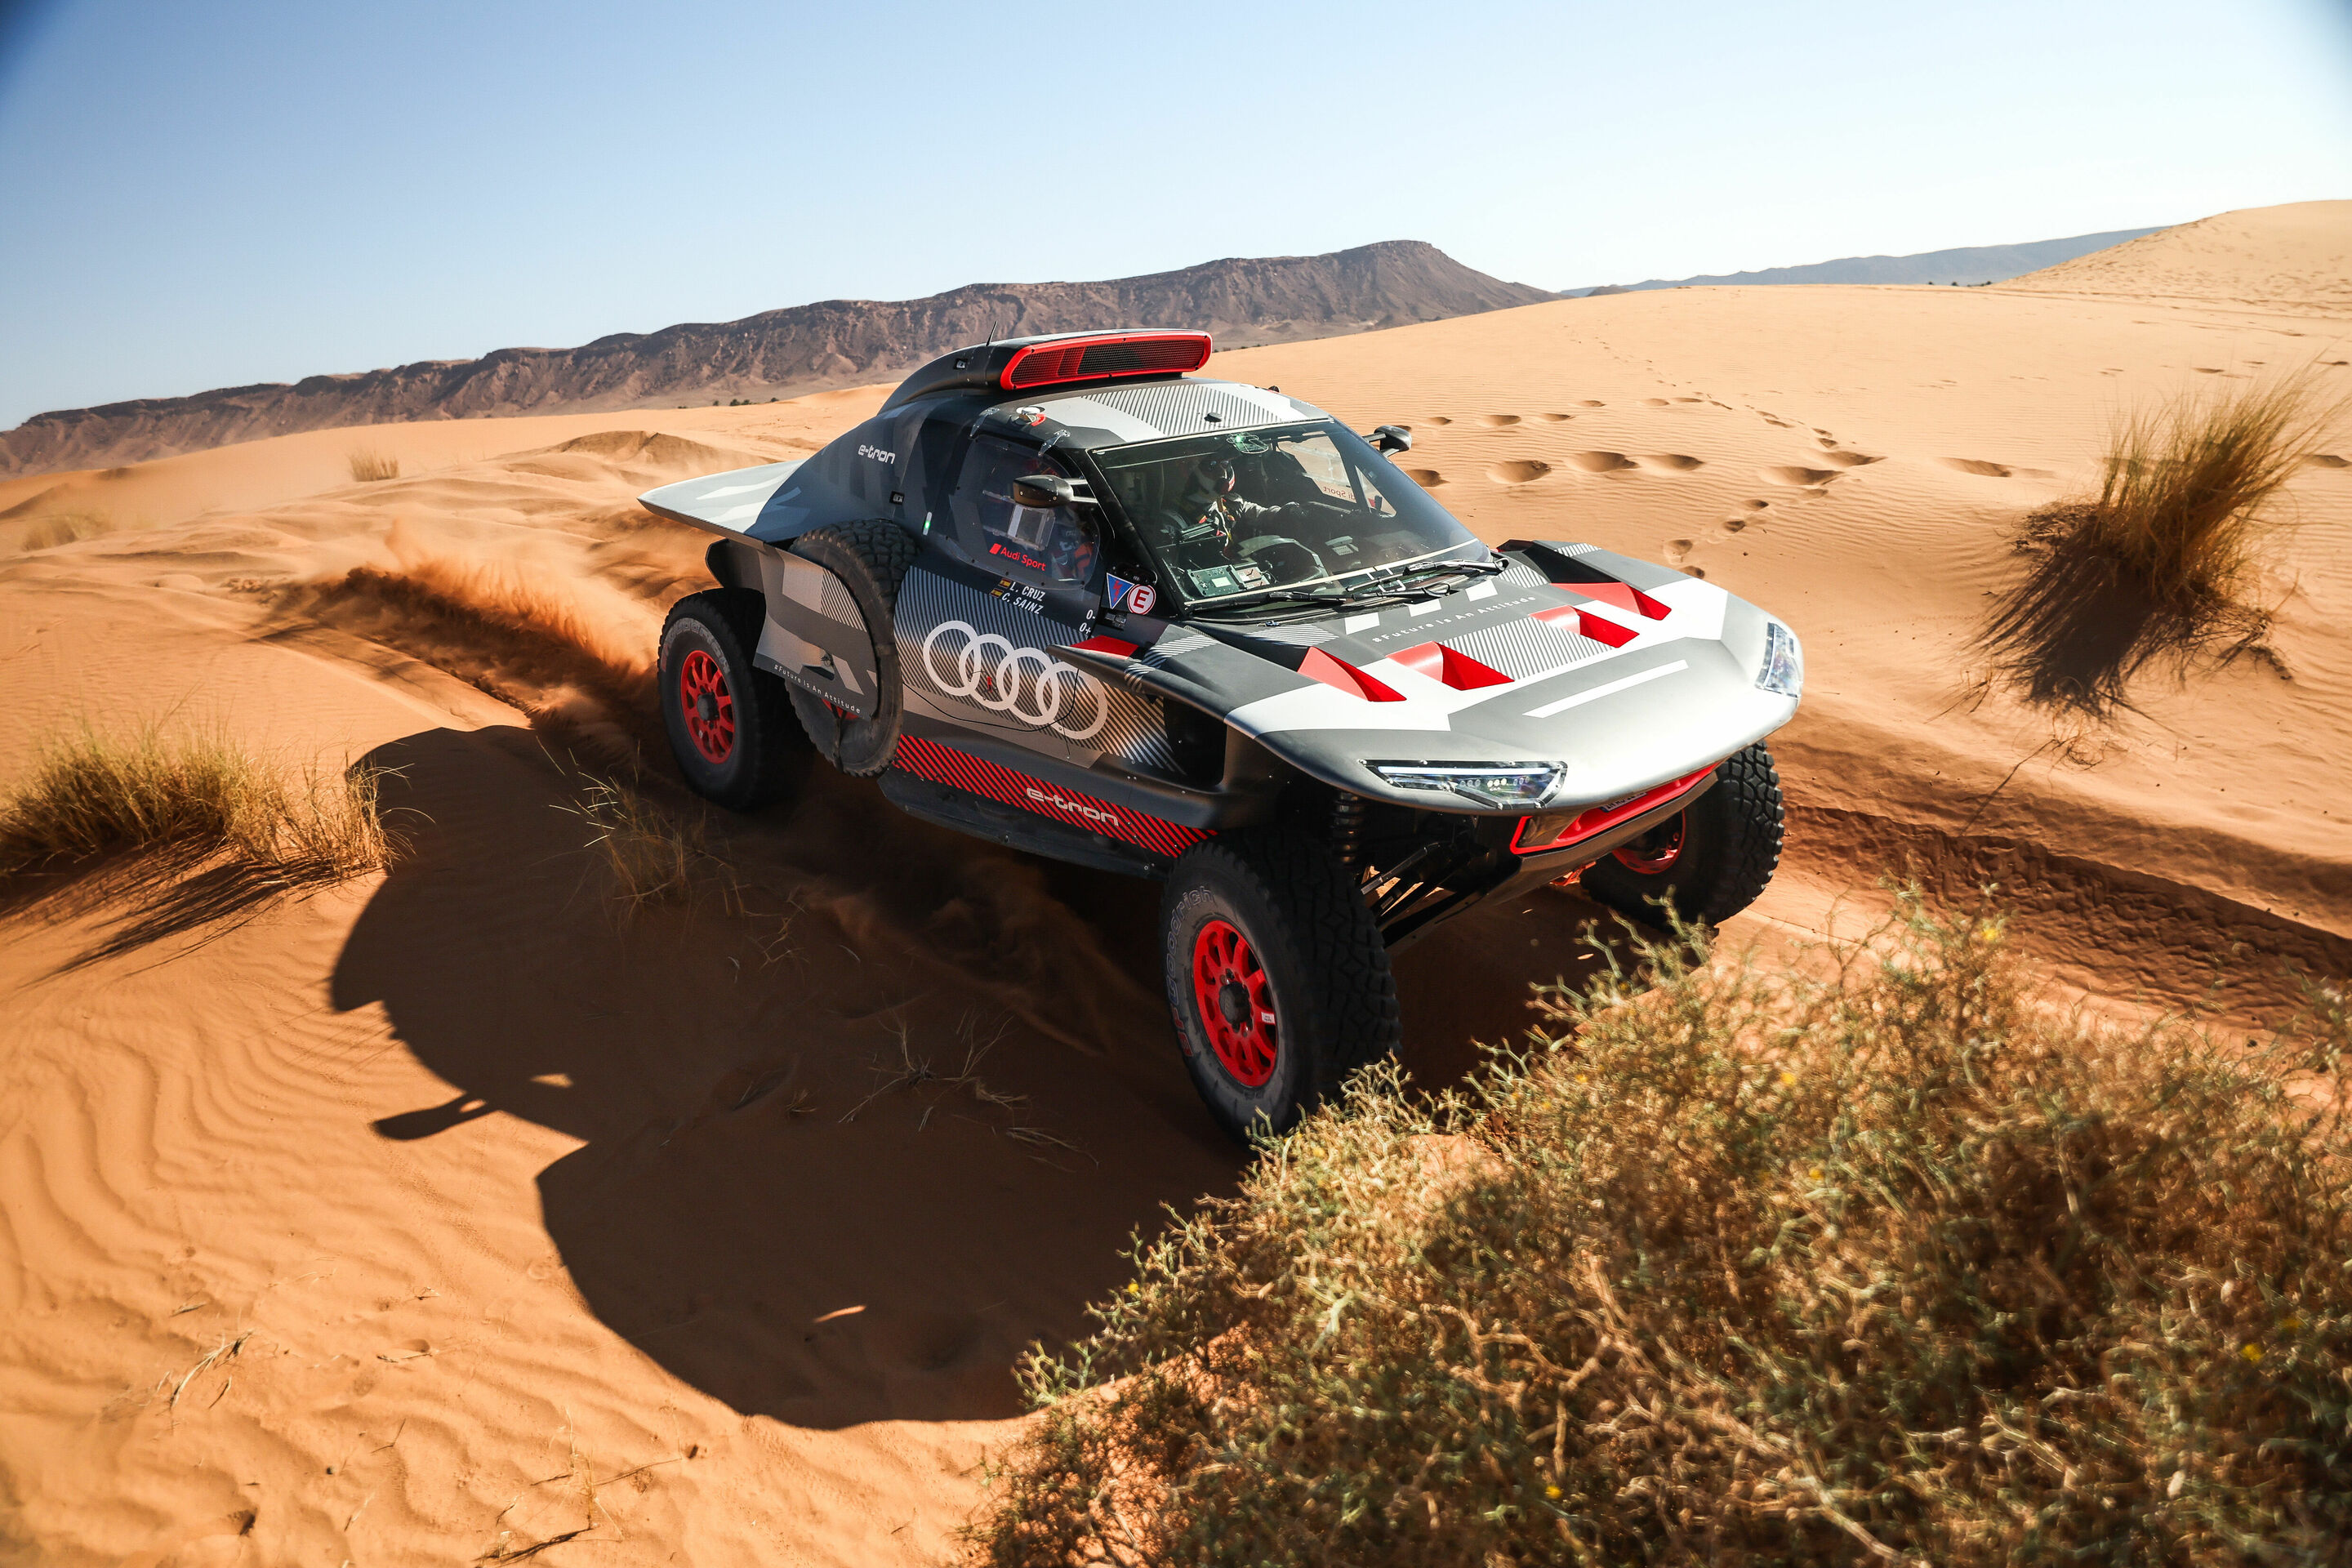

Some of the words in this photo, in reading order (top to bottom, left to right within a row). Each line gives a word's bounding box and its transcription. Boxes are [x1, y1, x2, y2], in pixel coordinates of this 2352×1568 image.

[858, 444, 896, 465] e-tron
[1000, 547, 1021, 561] Audi
[1022, 555, 1046, 572] Sport
[1009, 581, 1019, 593] L.
[1022, 586, 1046, 602] CRUZ
[1133, 589, 1150, 609] E
[1001, 592, 1011, 603] C.
[1013, 596, 1045, 615] SAINZ
[824, 692, 861, 714] Attitude
[1026, 787, 1119, 826] e-tron
